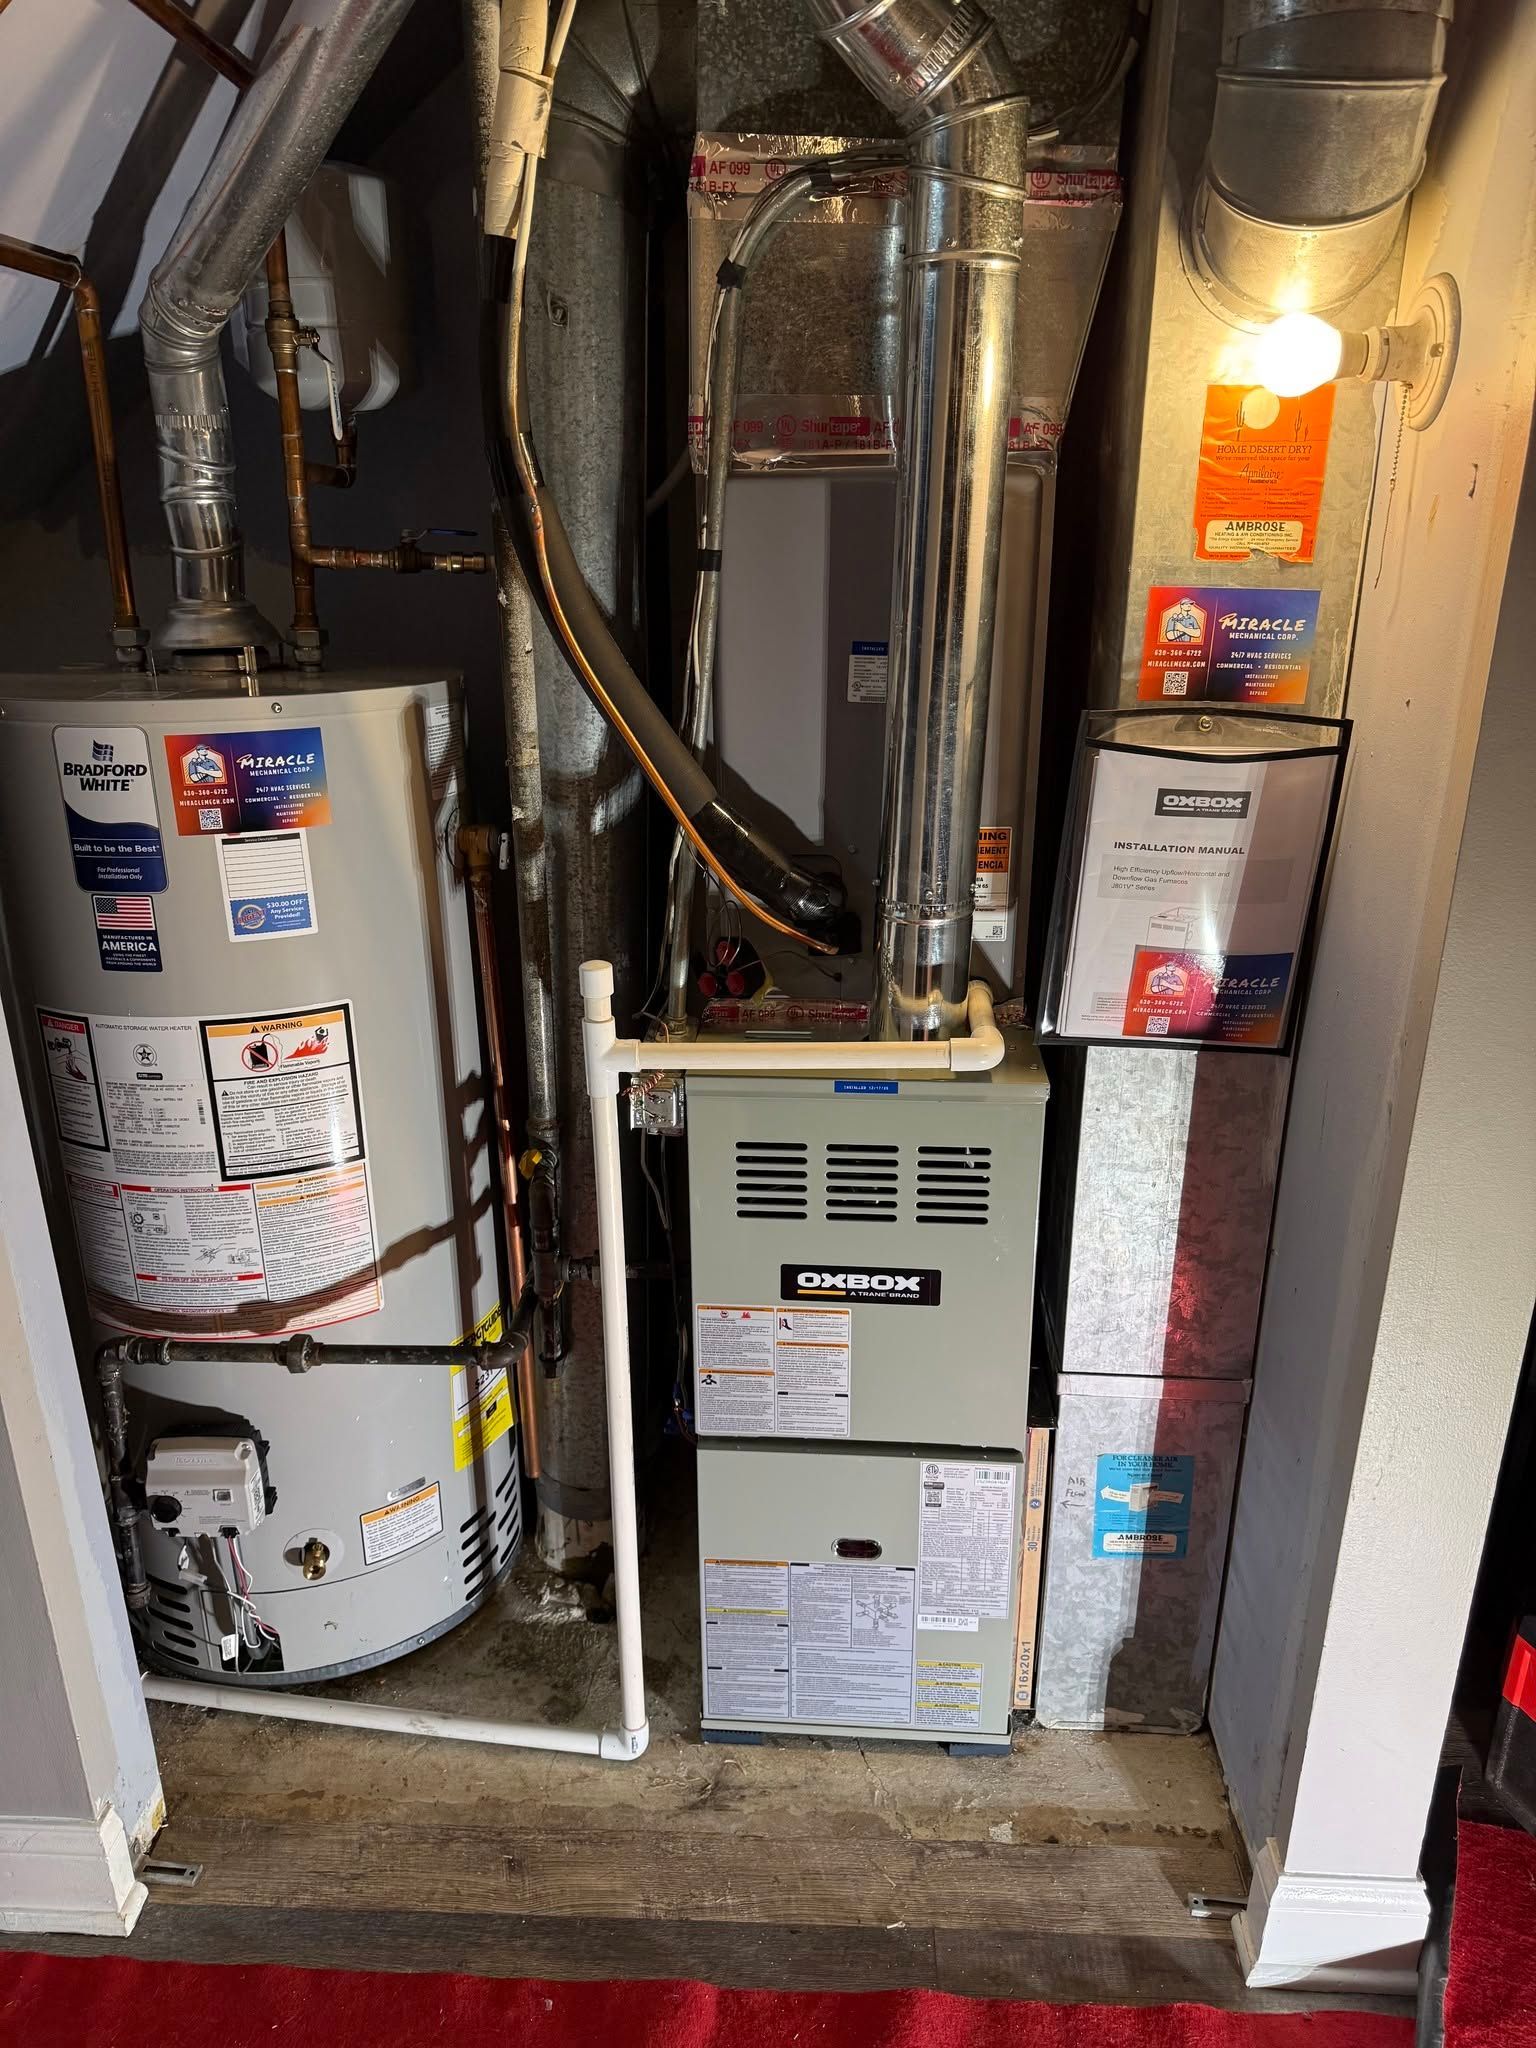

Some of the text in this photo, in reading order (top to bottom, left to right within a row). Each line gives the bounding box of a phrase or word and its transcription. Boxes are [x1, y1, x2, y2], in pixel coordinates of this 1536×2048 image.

[709, 160, 726, 175] AF
[729, 161, 751, 176] 099
[744, 421, 764, 433] 099
[801, 418, 861, 434] Shurtape
[1023, 422, 1063, 436] AF 099
[1217, 445, 1312, 454] HOME DESERT DRY?
[1225, 521, 1286, 532] AMBROSE
[1218, 613, 1307, 632] MIRACLE
[1229, 632, 1299, 641] MECHANICAL CORP.
[1230, 651, 1246, 659] 24/7
[1263, 652, 1292, 660] SERVICES
[236, 753, 315, 769] MIRACLE
[63, 762, 147, 777] BRADFORD
[250, 768, 293, 777] MECHANICAL
[80, 778, 130, 792] WHITE
[286, 783, 311, 791] SERVICES
[245, 792, 322, 804] COMMERCIAL RESIDENTIAL
[1163, 794, 1243, 808] OXBOX
[74, 843, 93, 851] Built
[135, 845, 156, 853] Best
[1114, 842, 1245, 855] INSTALLATION MANUAL
[1129, 867, 1160, 875] Efficiency
[1112, 874, 1143, 882] Downflow
[1158, 877, 1188, 885] Furnaces
[266, 901, 289, 909] $30.00
[102, 941, 158, 952] AMERICA
[758, 1009, 776, 1018] 099
[54, 1021, 80, 1032] DANGER
[261, 1020, 303, 1032] WARNING
[304, 1174, 327, 1183] WARNING
[797, 1272, 920, 1292] OXBOX
[1067, 1476, 1086, 1487] AIR
[389, 1495, 420, 1514] WARNING
[1117, 1534, 1164, 1542] AMBROSE
[1027, 1541, 1038, 1552] 30
[1018, 1641, 1031, 1689] 16x20x1
